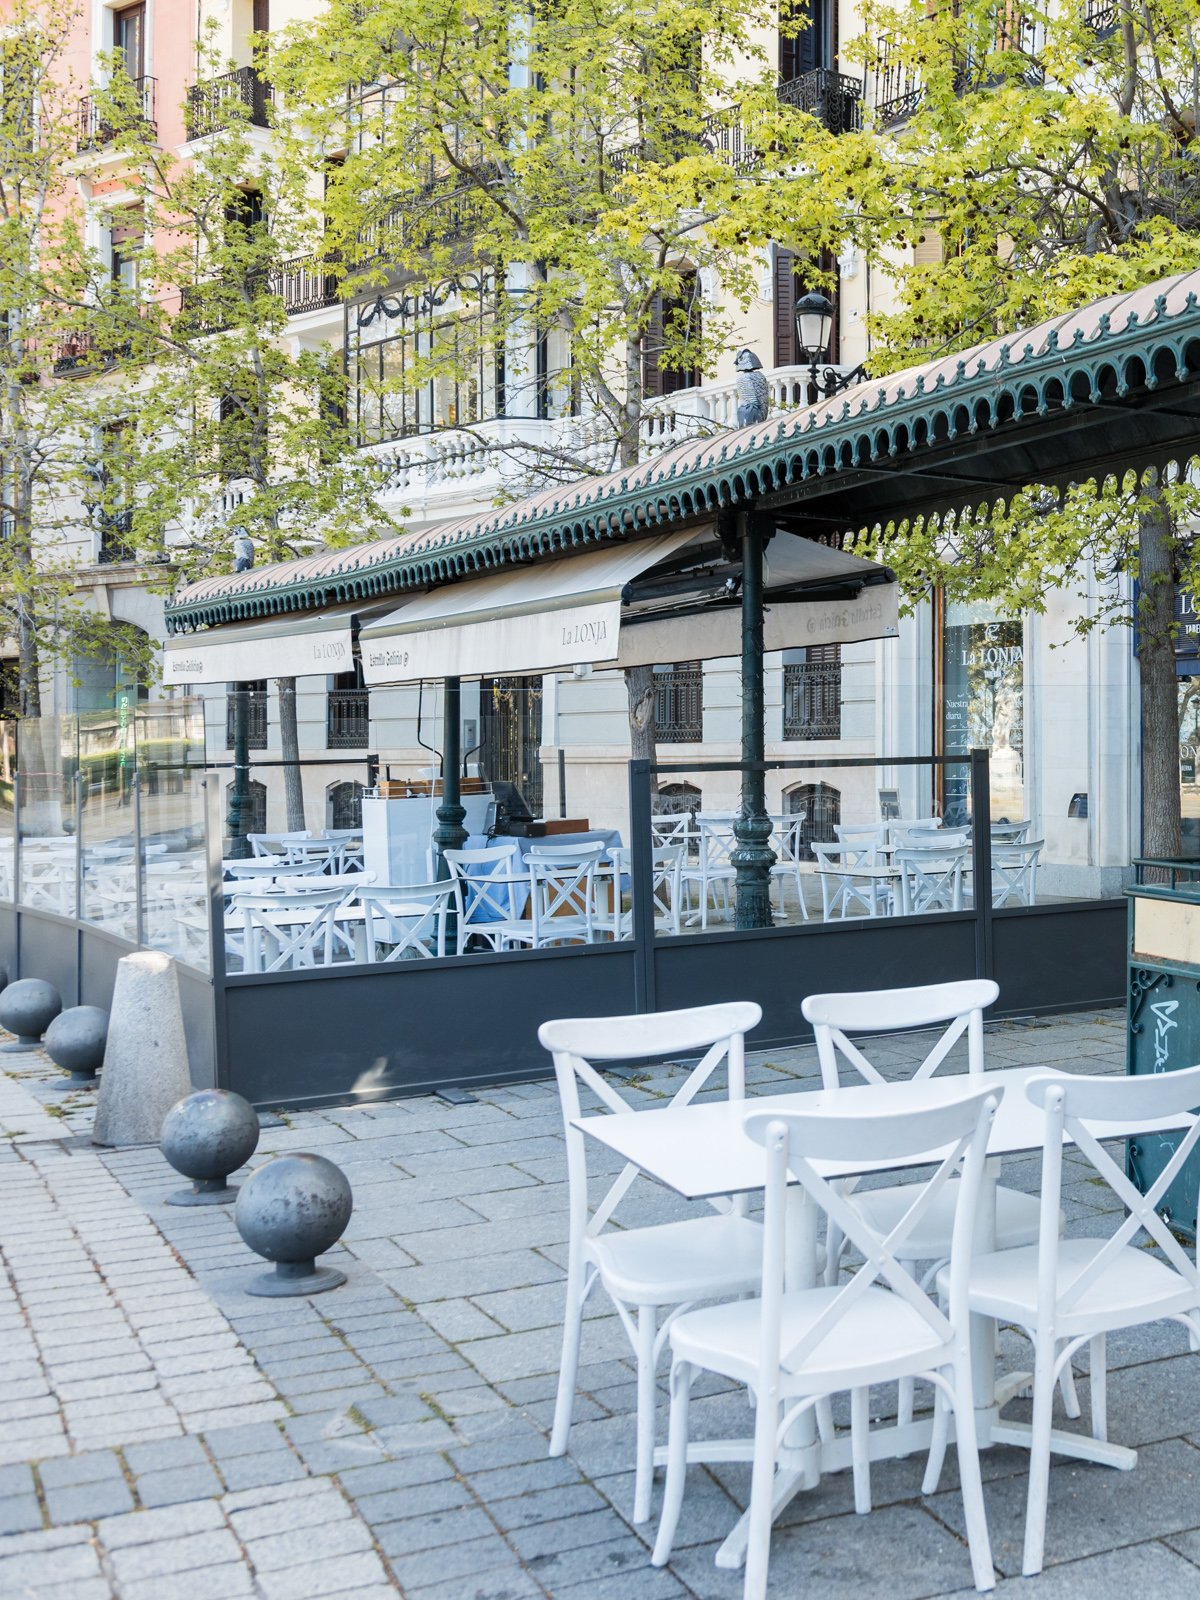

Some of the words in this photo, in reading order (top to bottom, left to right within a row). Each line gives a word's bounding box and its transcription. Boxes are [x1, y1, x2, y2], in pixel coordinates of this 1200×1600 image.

[562, 627, 571, 645] La
[573, 620, 606, 645] LONJA
[961, 650, 976, 666] La
[980, 645, 1023, 668] LONJA
[946, 700, 968, 708] Nuestra
[946, 712, 962, 720] diaria
